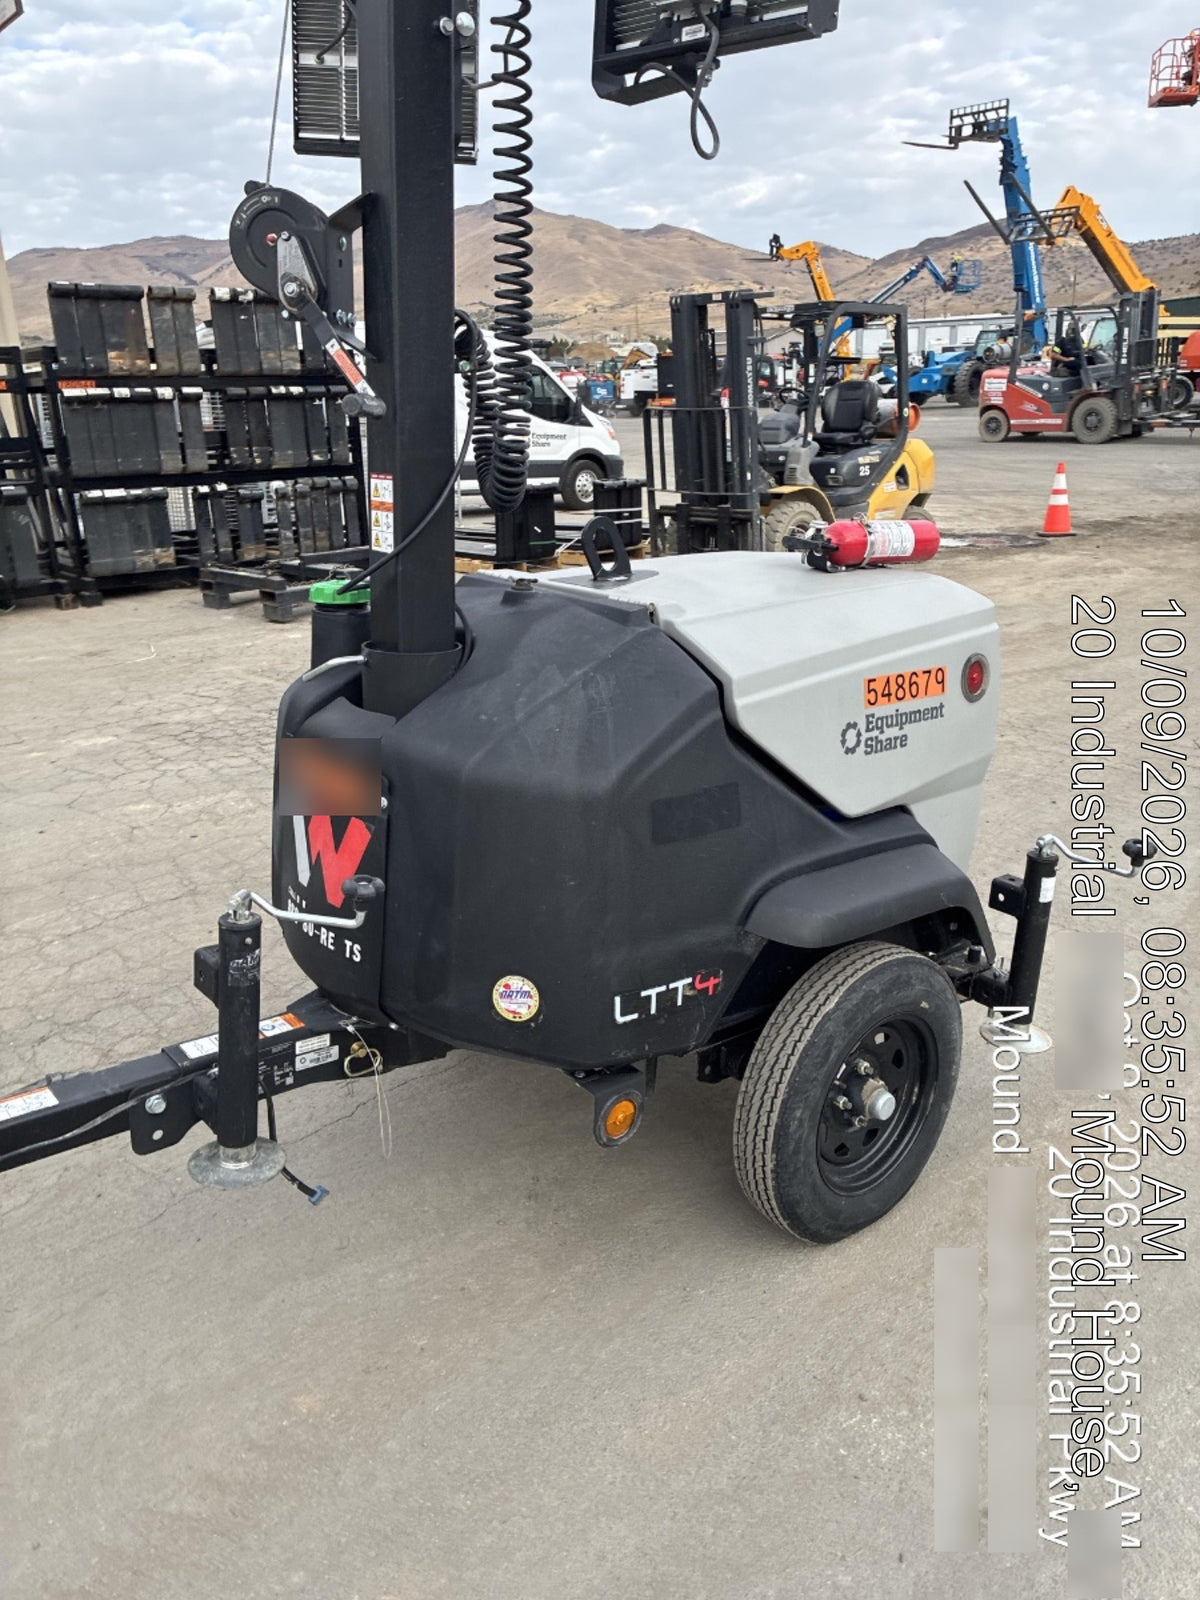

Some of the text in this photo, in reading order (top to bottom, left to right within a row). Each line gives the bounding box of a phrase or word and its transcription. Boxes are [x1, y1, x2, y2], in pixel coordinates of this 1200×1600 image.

[531, 432, 567, 441] Equipment
[859, 465, 870, 476] 25
[867, 667, 945, 706] 548679
[864, 702, 945, 734] Equipment
[864, 733, 908, 756] Share
[614, 973, 720, 1024] LTT4
